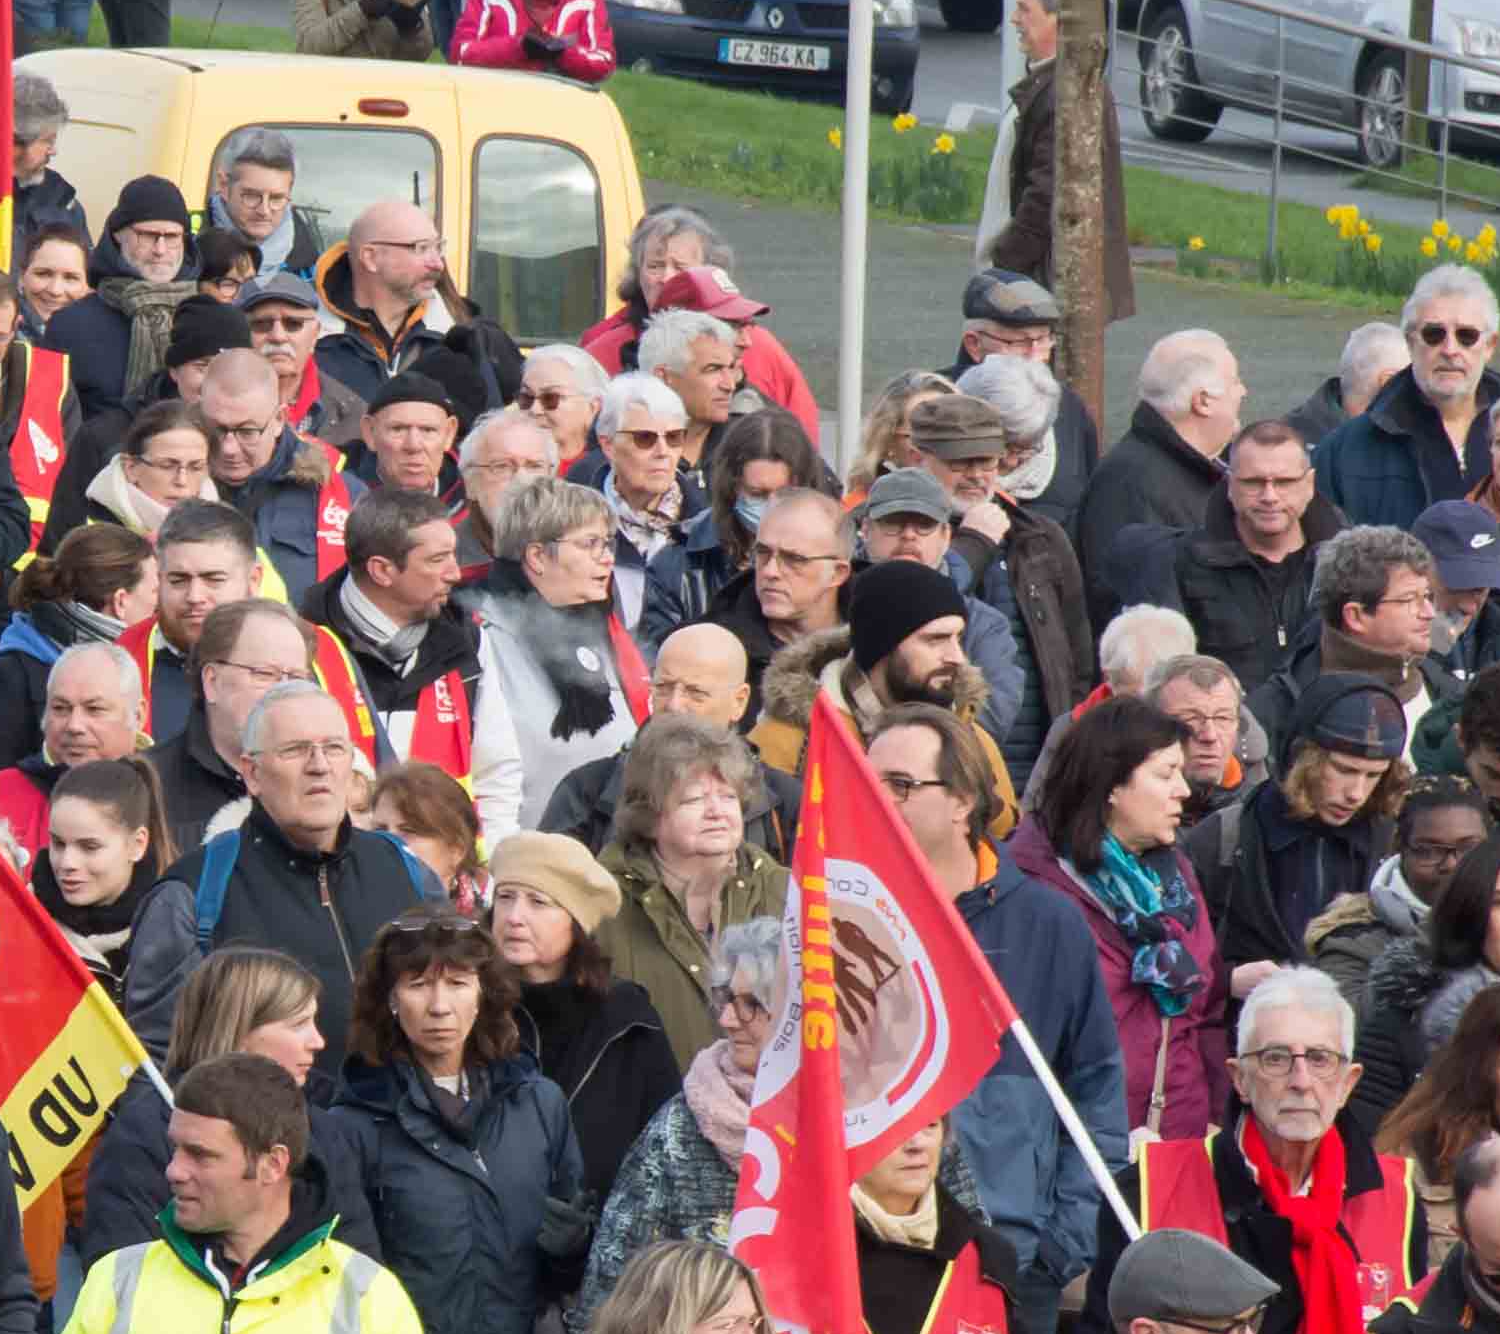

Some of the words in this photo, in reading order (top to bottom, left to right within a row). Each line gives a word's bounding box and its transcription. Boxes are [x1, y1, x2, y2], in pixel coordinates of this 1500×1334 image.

[733, 41, 753, 64] CZ
[759, 43, 791, 66] 964
[794, 45, 816, 67] KA
